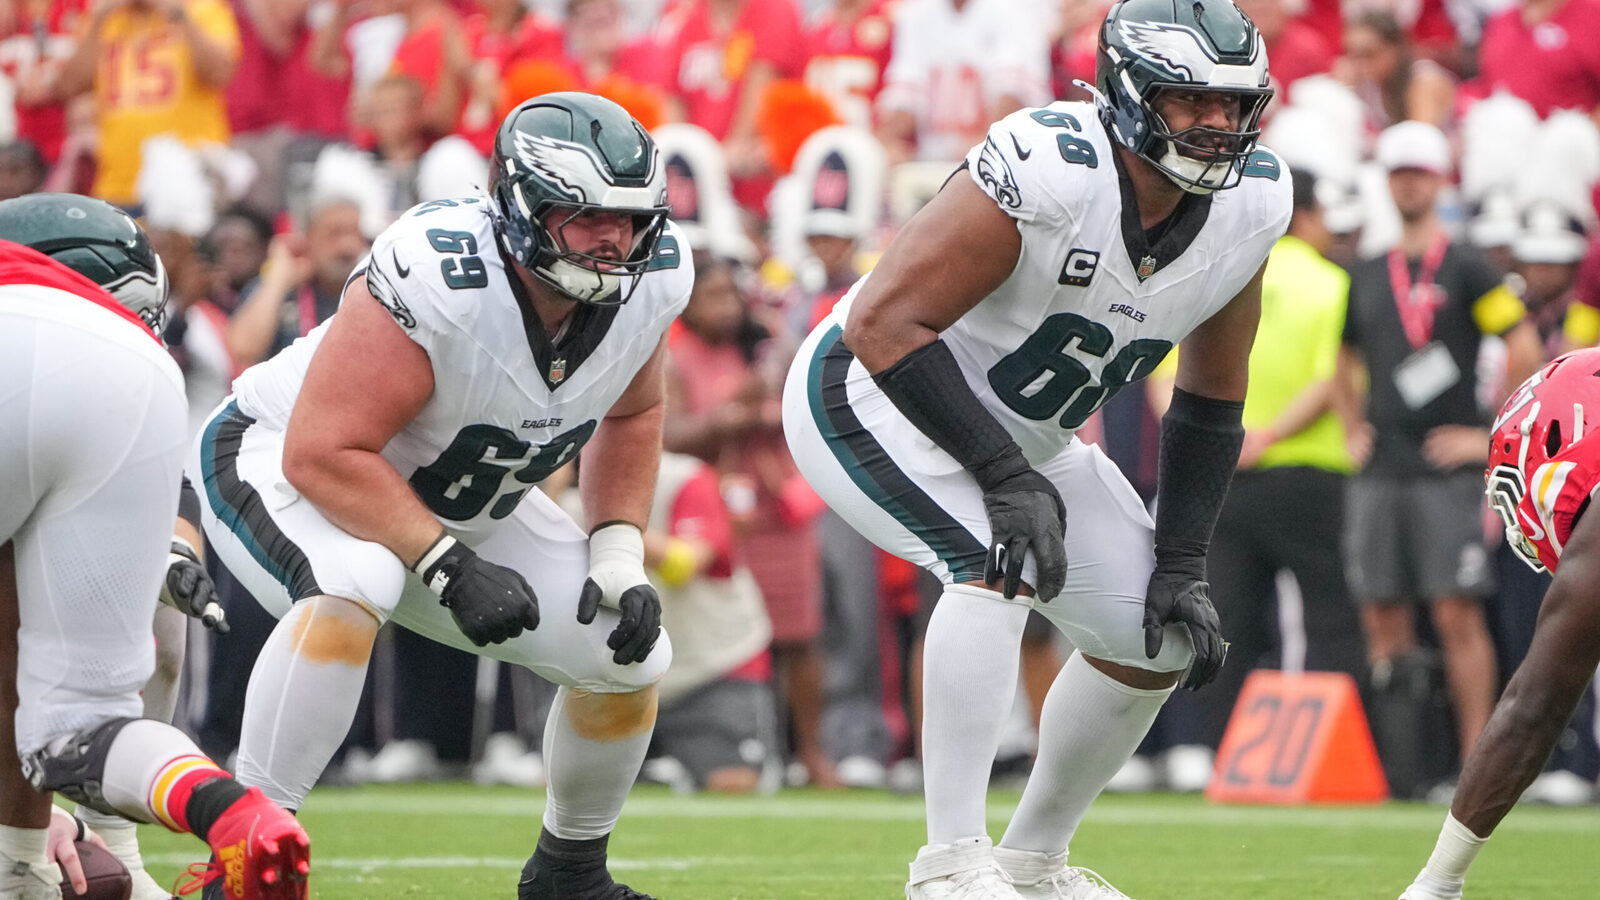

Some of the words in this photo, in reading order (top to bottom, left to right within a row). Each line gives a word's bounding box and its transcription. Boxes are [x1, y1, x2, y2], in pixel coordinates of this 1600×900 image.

[1029, 109, 1098, 169] 68
[425, 228, 488, 290] 69
[1065, 251, 1097, 278] C
[1108, 303, 1147, 323] EAGLES
[987, 312, 1174, 429] 68
[521, 418, 563, 429] EAGLES
[408, 418, 598, 521] 69
[1225, 693, 1325, 787] 20
